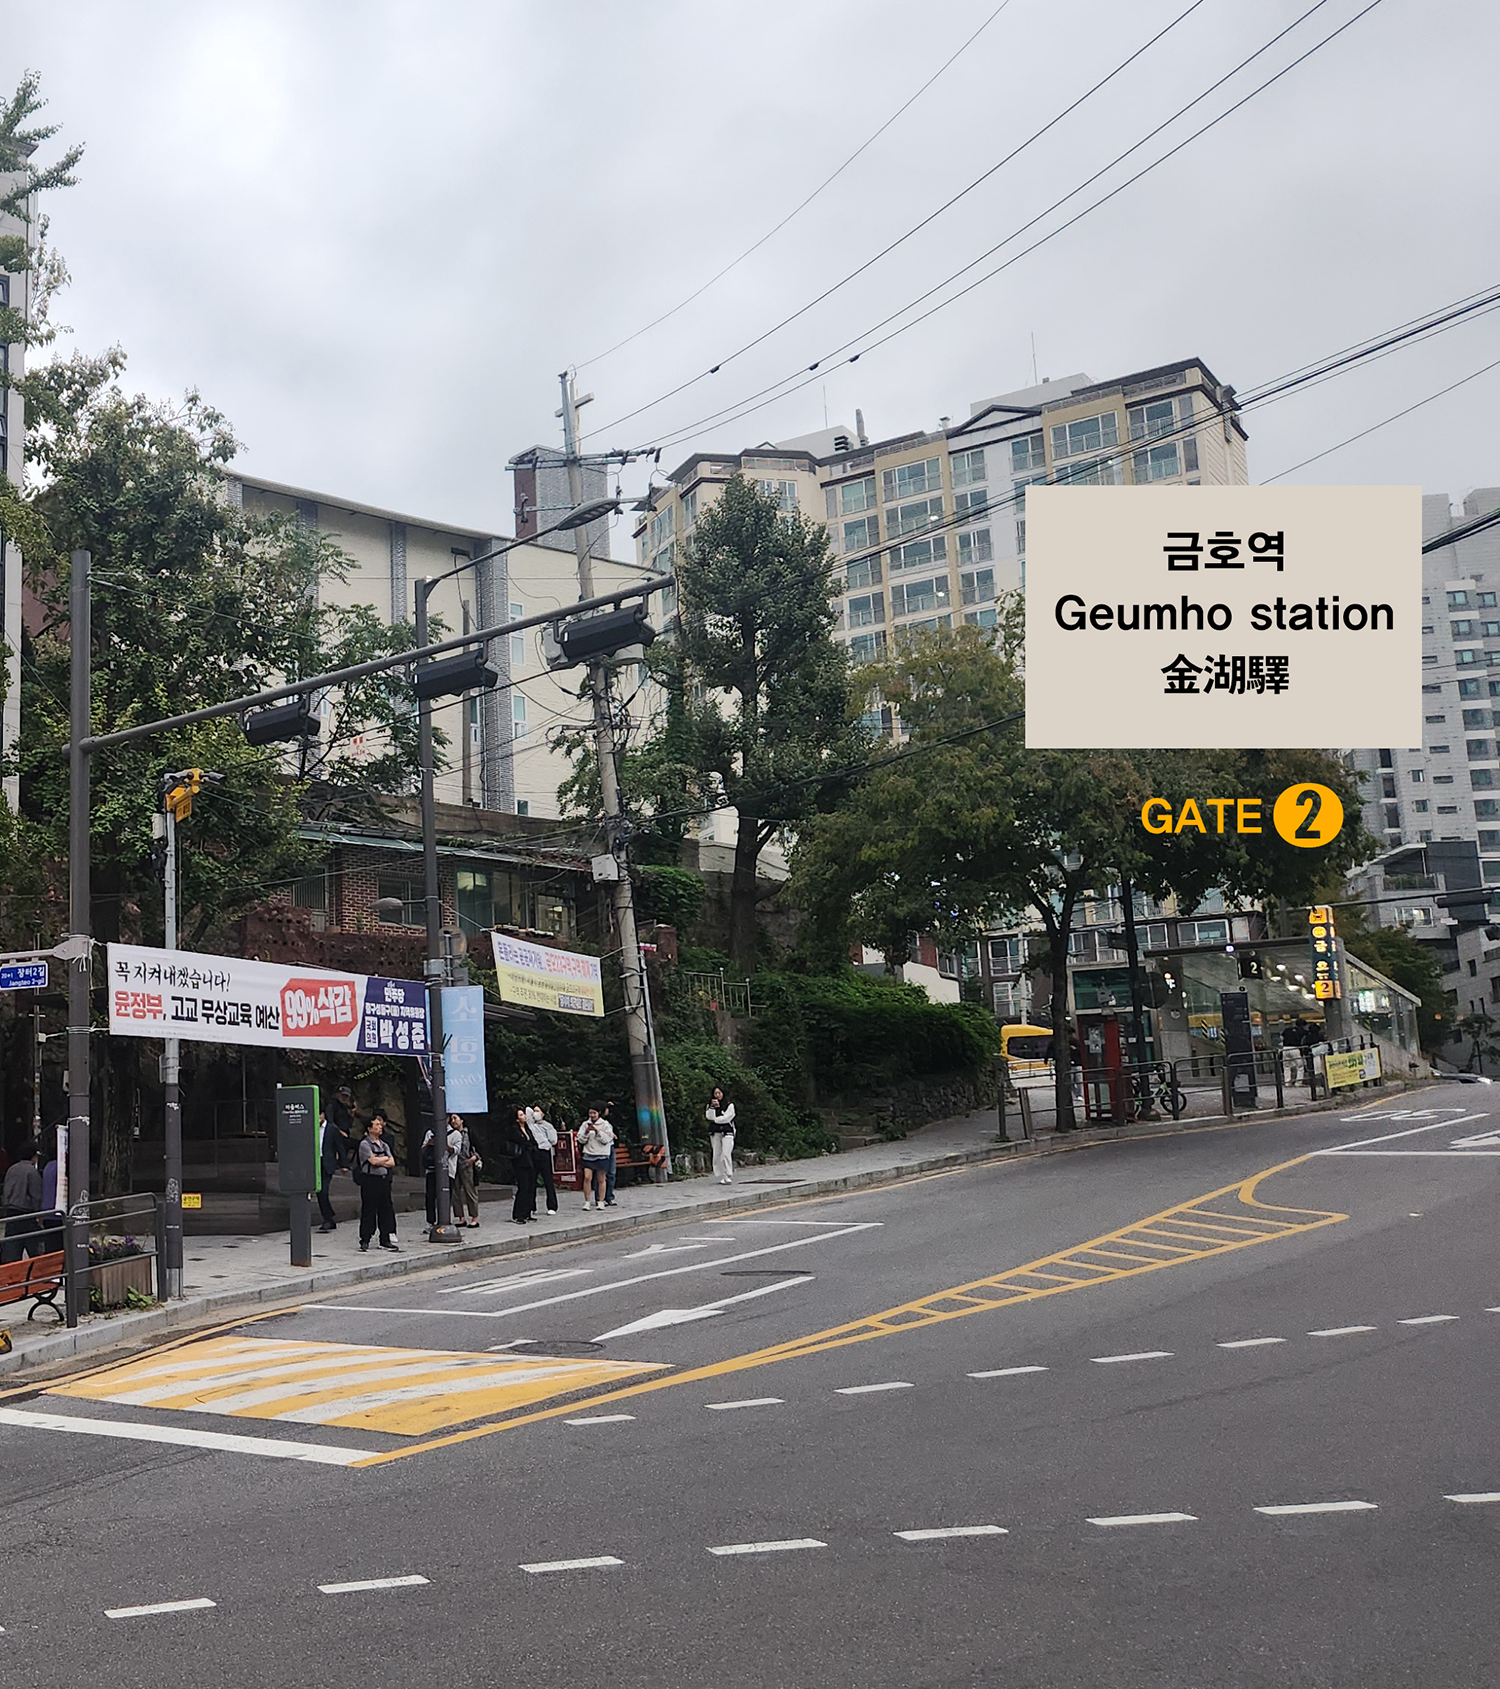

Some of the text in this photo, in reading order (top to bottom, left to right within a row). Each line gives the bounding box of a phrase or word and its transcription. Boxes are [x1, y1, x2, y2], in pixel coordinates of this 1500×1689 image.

[17, 966, 45, 978] 장터2길
[115, 961, 230, 992] 꼭 지켜내겠습니다!
[1250, 961, 1258, 974] 2
[1320, 982, 1330, 993] 2
[115, 990, 280, 1030] 윤정부, 고교 무상교육 예산
[379, 1019, 425, 1050] 박성준
